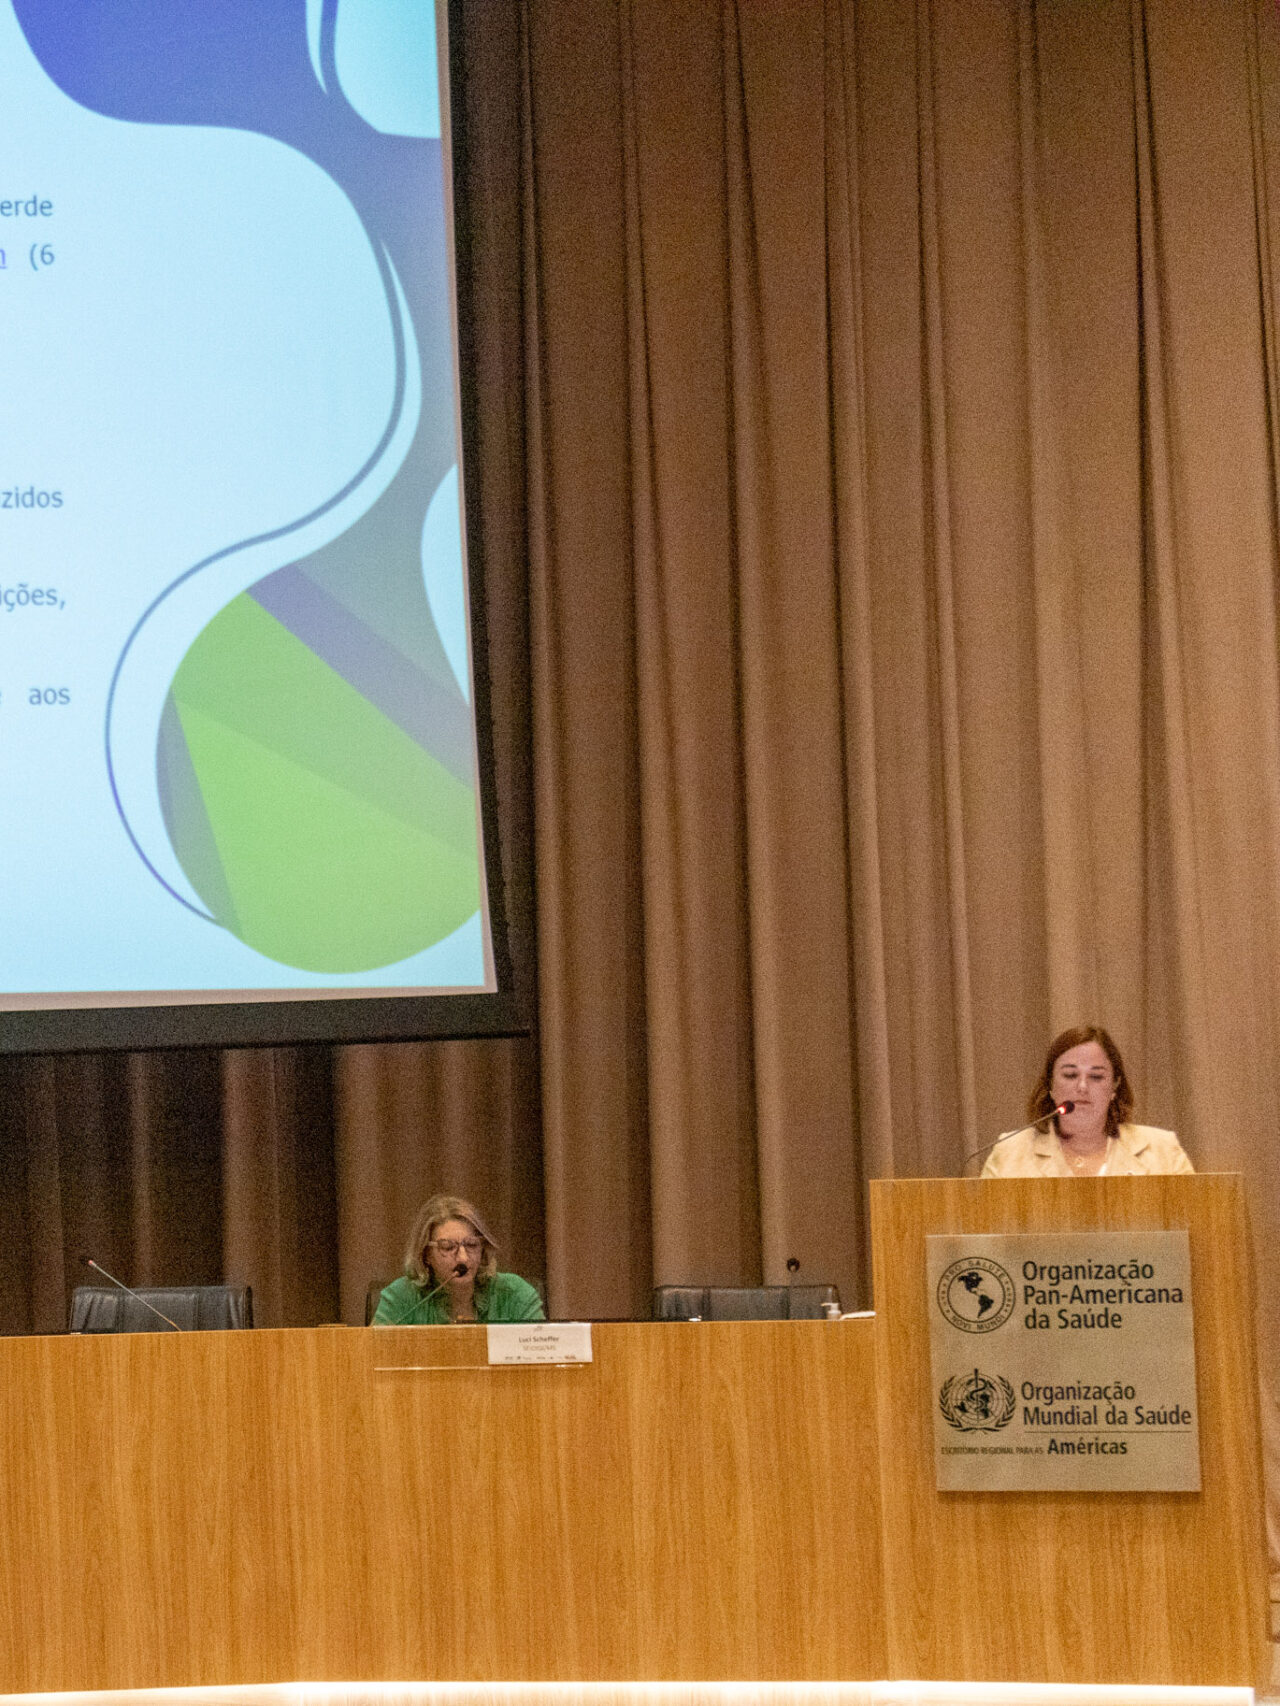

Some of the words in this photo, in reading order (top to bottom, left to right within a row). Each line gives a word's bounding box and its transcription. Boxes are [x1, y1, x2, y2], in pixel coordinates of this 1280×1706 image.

[29, 243, 55, 271] (6
[28, 687, 71, 705] aos
[1022, 1258, 1155, 1287] Organização
[1023, 1284, 1184, 1305] Pan-Americana
[1024, 1307, 1051, 1330] da
[1057, 1306, 1123, 1330] Saúde
[1021, 1380, 1136, 1406] Organização
[1022, 1404, 1098, 1426] Mundial
[1105, 1404, 1128, 1426] da
[1134, 1403, 1192, 1426] Saúde
[1046, 1437, 1128, 1455] Américas
